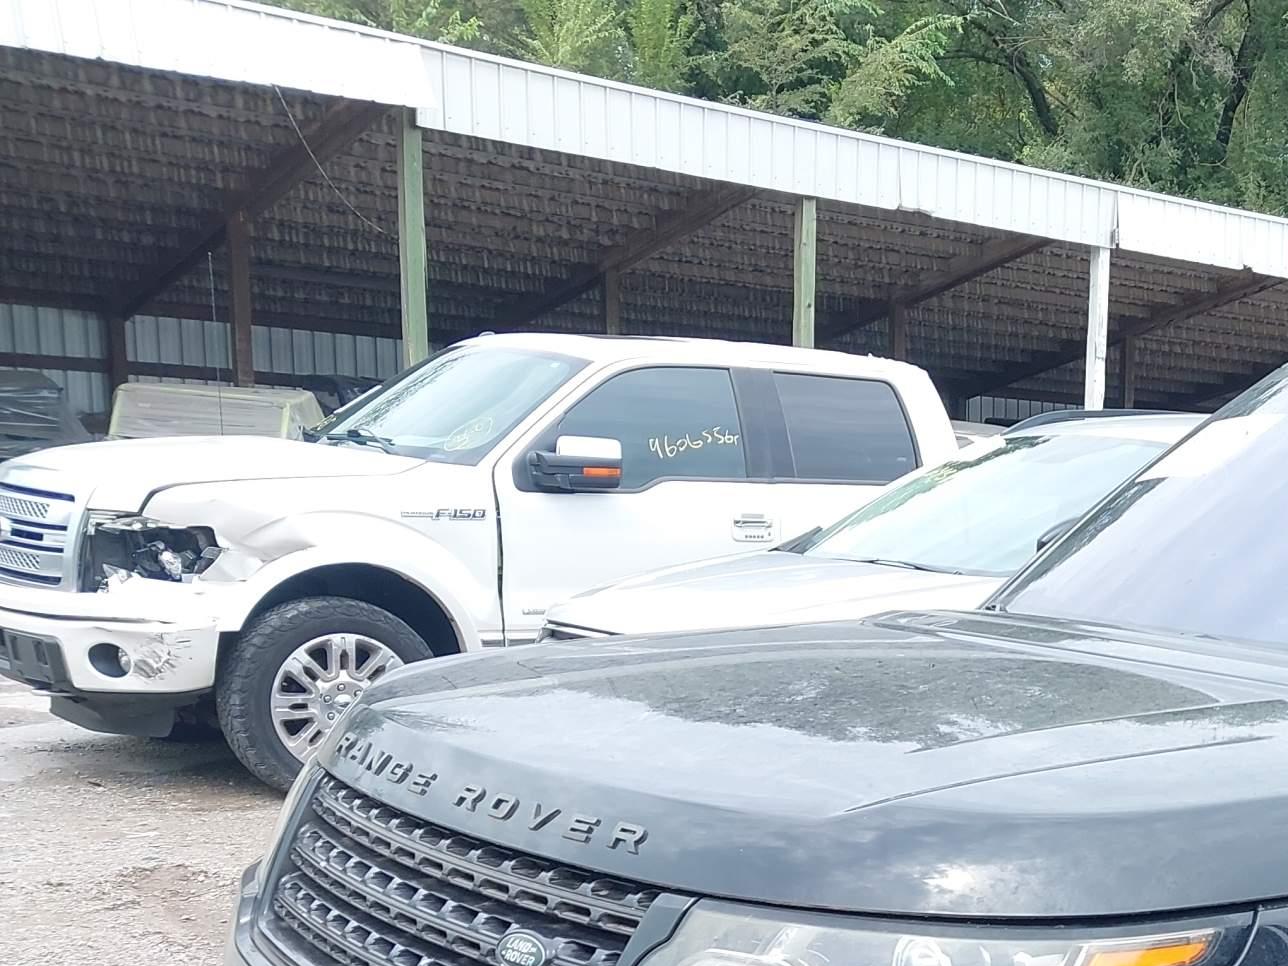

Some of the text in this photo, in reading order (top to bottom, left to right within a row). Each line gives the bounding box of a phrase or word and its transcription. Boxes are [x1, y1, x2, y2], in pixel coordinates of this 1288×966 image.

[434, 508, 487, 520] F-150
[335, 731, 649, 856] RANGE ROVER
